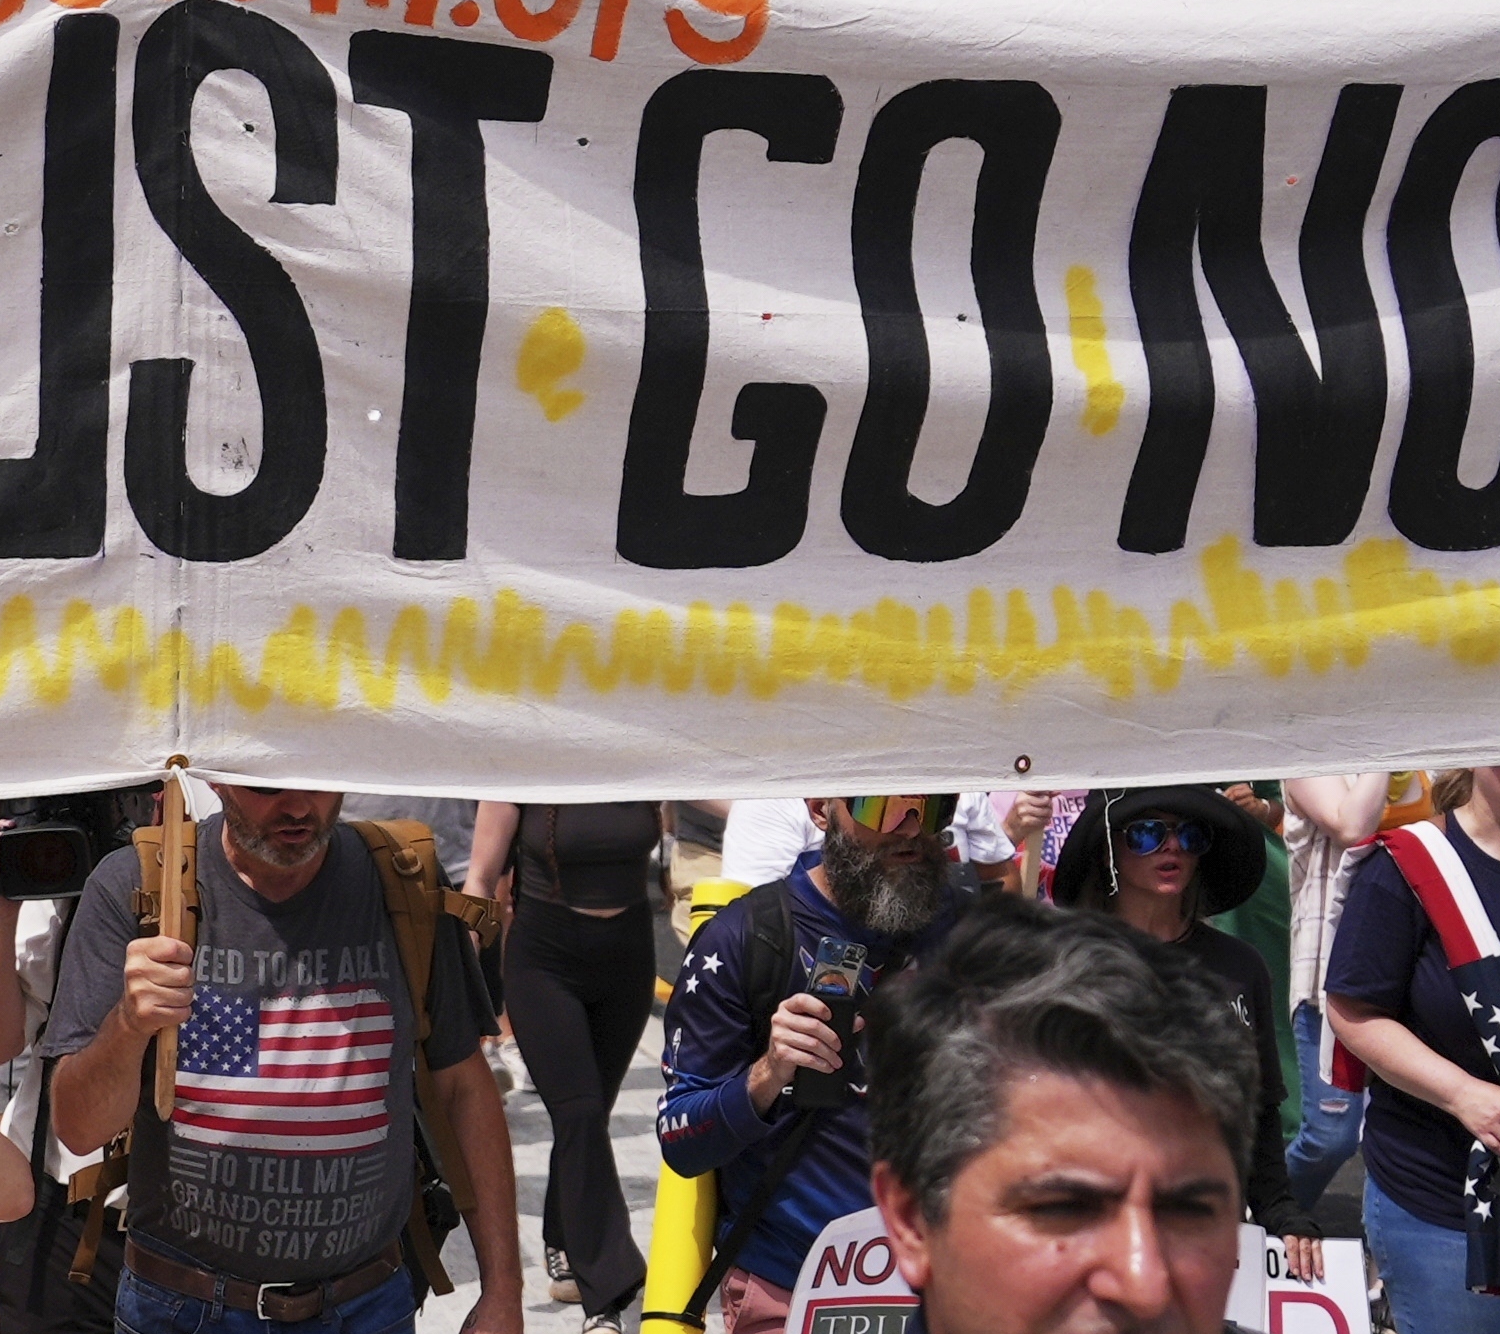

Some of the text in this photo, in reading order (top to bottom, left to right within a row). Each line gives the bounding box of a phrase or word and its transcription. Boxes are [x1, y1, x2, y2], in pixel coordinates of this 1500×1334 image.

[617, 71, 1063, 570] GO
[253, 950, 287, 988] TO
[297, 948, 329, 985] BE
[208, 1151, 355, 1194] TO TELL MY
[207, 1218, 249, 1253] NOT
[256, 1229, 318, 1261] STAY
[811, 1236, 898, 1289] NO
